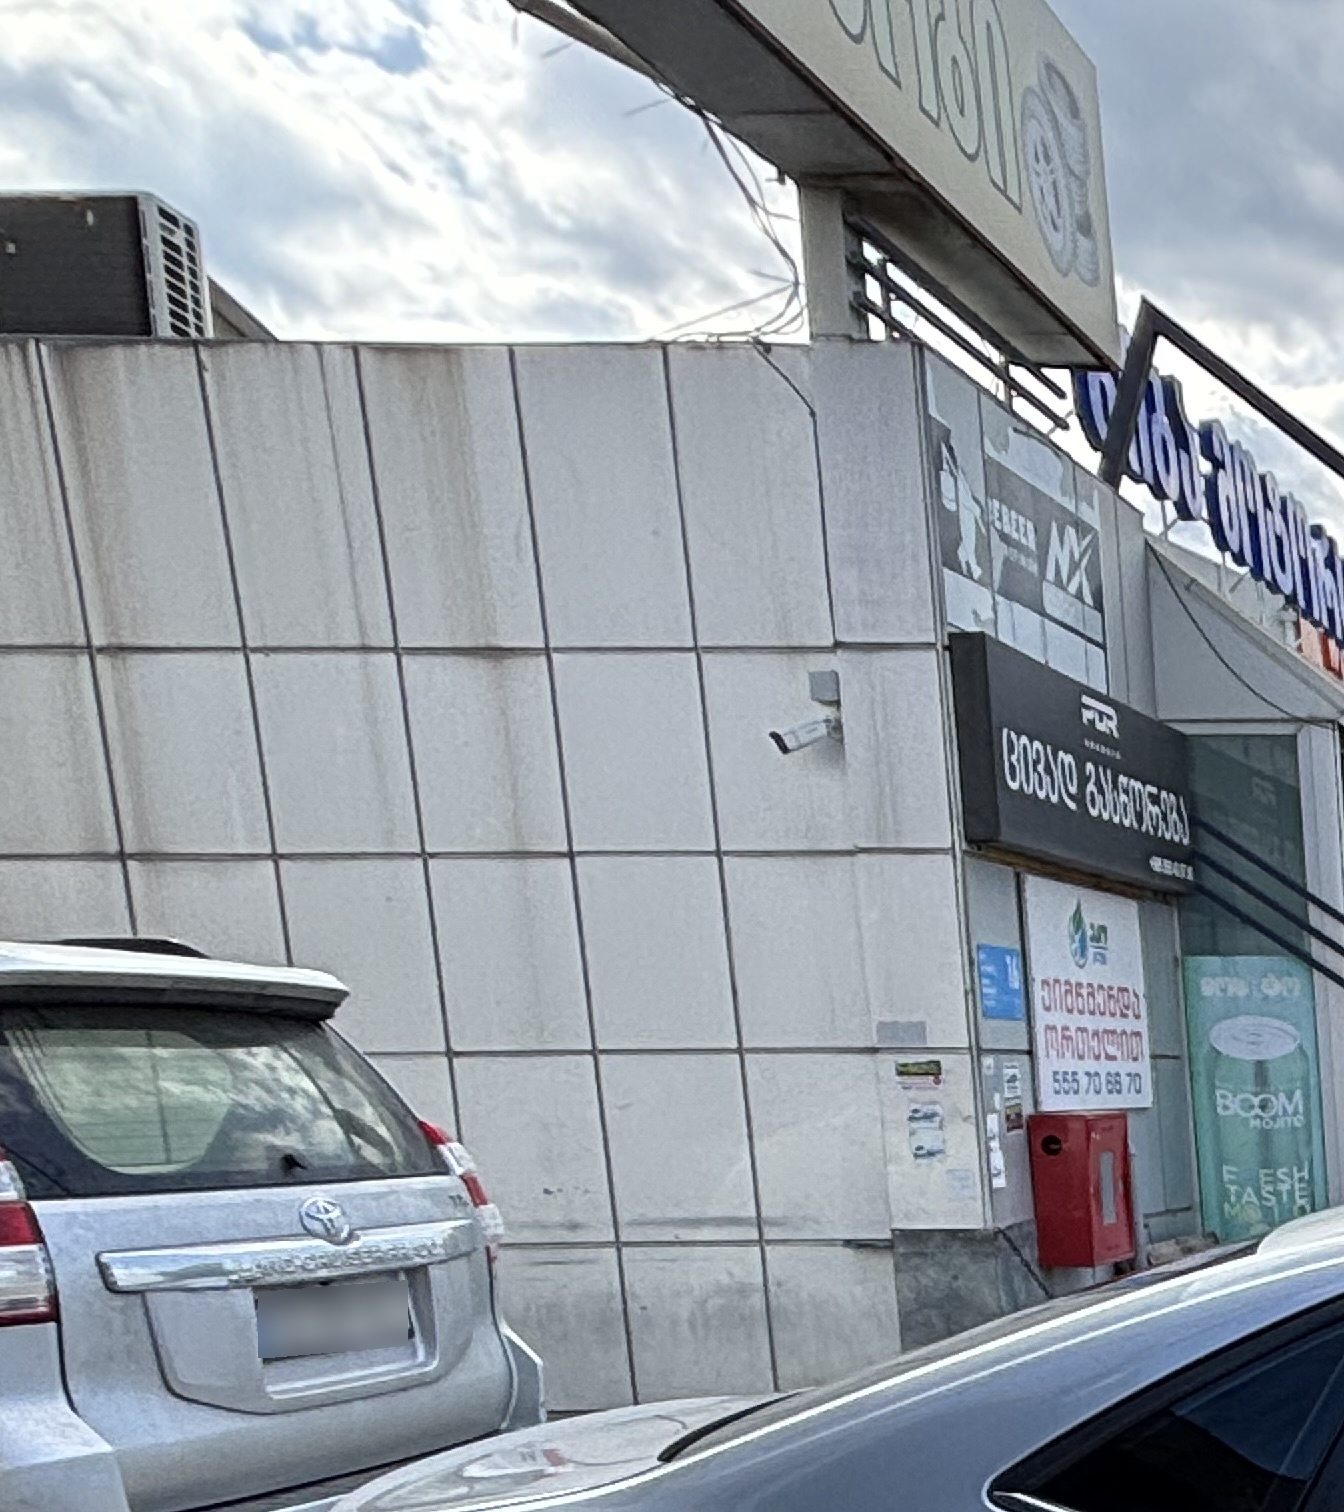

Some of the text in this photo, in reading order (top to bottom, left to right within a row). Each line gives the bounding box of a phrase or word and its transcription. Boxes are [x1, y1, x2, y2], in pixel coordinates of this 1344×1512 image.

[1002, 727, 1078, 811] ცივად
[1052, 1070, 1080, 1095] 555
[1084, 1070, 1102, 1096] 70
[1125, 1071, 1142, 1096] 70
[1215, 1088, 1304, 1118] BOOM
[1249, 1114, 1305, 1130] MOJITO
[1225, 1181, 1308, 1206] TASTE
